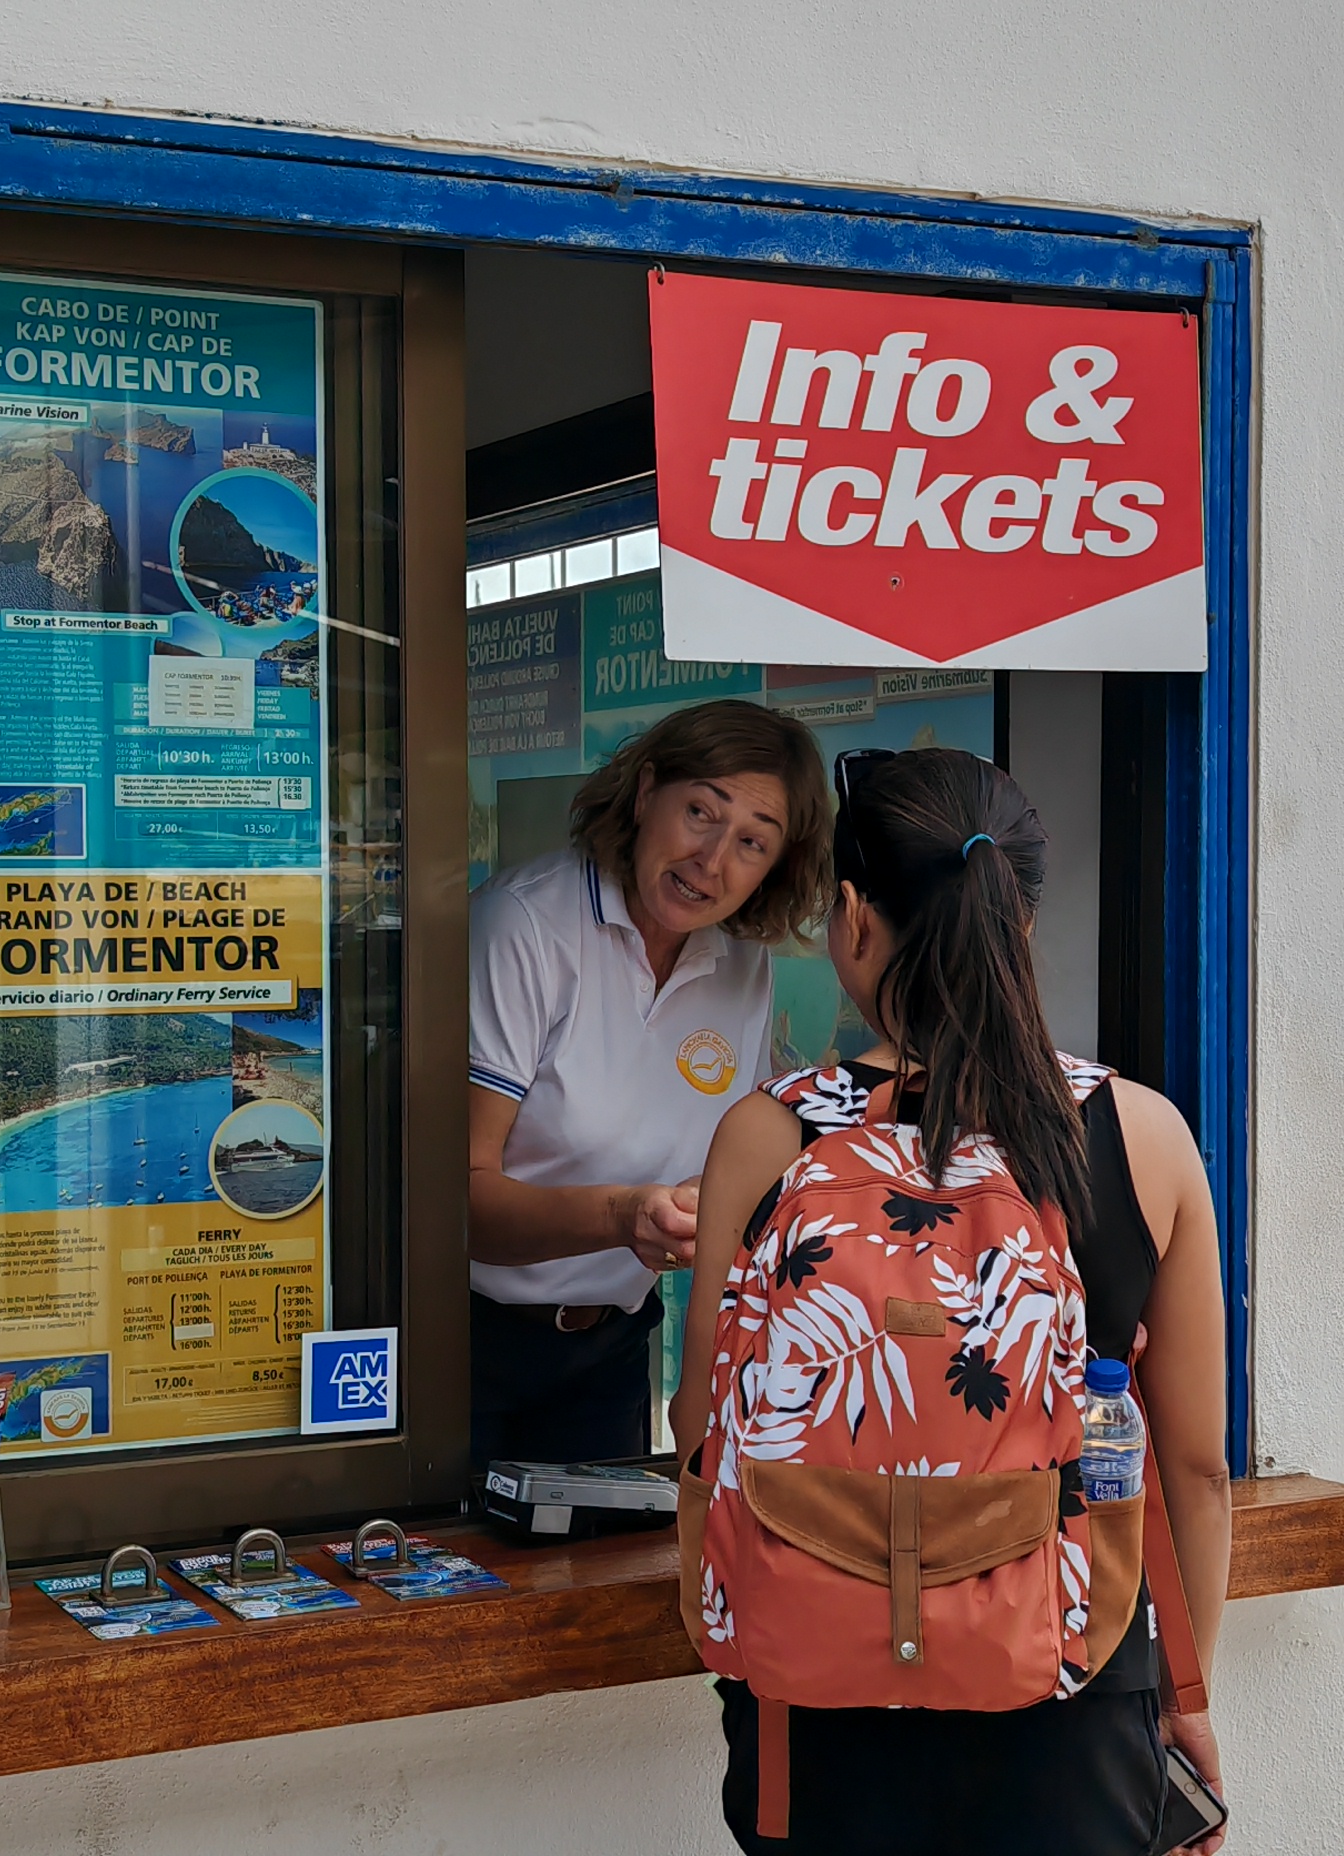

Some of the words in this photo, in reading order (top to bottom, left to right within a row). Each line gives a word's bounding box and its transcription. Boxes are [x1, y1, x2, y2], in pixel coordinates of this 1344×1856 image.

[21, 297, 89, 319] CABO
[98, 304, 128, 323] DE
[136, 306, 143, 325] /
[151, 308, 220, 330] POINT
[16, 322, 66, 343] KAP
[74, 328, 126, 348] VON
[134, 332, 141, 349] /
[148, 332, 194, 353] CAP
[202, 336, 233, 356] DE
[728, 320, 991, 437] Info
[1025, 344, 1134, 445] &
[36, 405, 79, 420] Vision
[709, 437, 1165, 558] tickets
[13, 615, 41, 630] Stop
[45, 616, 57, 627] at
[59, 617, 122, 630] Formentor
[125, 619, 158, 631] Beach
[162, 751, 199, 764] 10'30
[201, 751, 214, 763] h.
[263, 752, 299, 764] 13'00
[302, 752, 313, 765] h.
[6, 883, 95, 903] PLAYA
[105, 883, 138, 902] DE
[147, 883, 154, 902] /
[163, 882, 247, 901] BEACH
[83, 910, 139, 929] VON
[147, 909, 154, 929] /
[163, 909, 244, 929] PLAGE
[254, 908, 286, 926] DE
[49, 990, 94, 1004] diario
[97, 991, 103, 1003] /
[107, 988, 173, 1005] Ordinary
[177, 987, 215, 1003] Ferry
[219, 986, 271, 1000] Service
[198, 1229, 242, 1242] FERRY
[173, 1248, 196, 1256] CADA
[221, 1245, 246, 1254] EVERY
[249, 1244, 267, 1252] DAY
[208, 1254, 230, 1263] TOUS
[232, 1253, 246, 1261] LES
[248, 1251, 273, 1260] JOURS
[127, 1276, 148, 1285] PORT
[152, 1275, 162, 1284] DE
[165, 1272, 208, 1284] POLLENÇA
[220, 1269, 246, 1279] PLAYA
[250, 1269, 260, 1277] DE
[262, 1265, 312, 1276] FORMENTOR
[124, 1306, 152, 1315] SALIDAS
[124, 1315, 164, 1323] DEPARTURES
[229, 1316, 269, 1325] ABFAHRTEN
[124, 1323, 165, 1333] ABFAHRTEN
[329, 1351, 388, 1384] AM
[338, 1379, 387, 1409] EX
